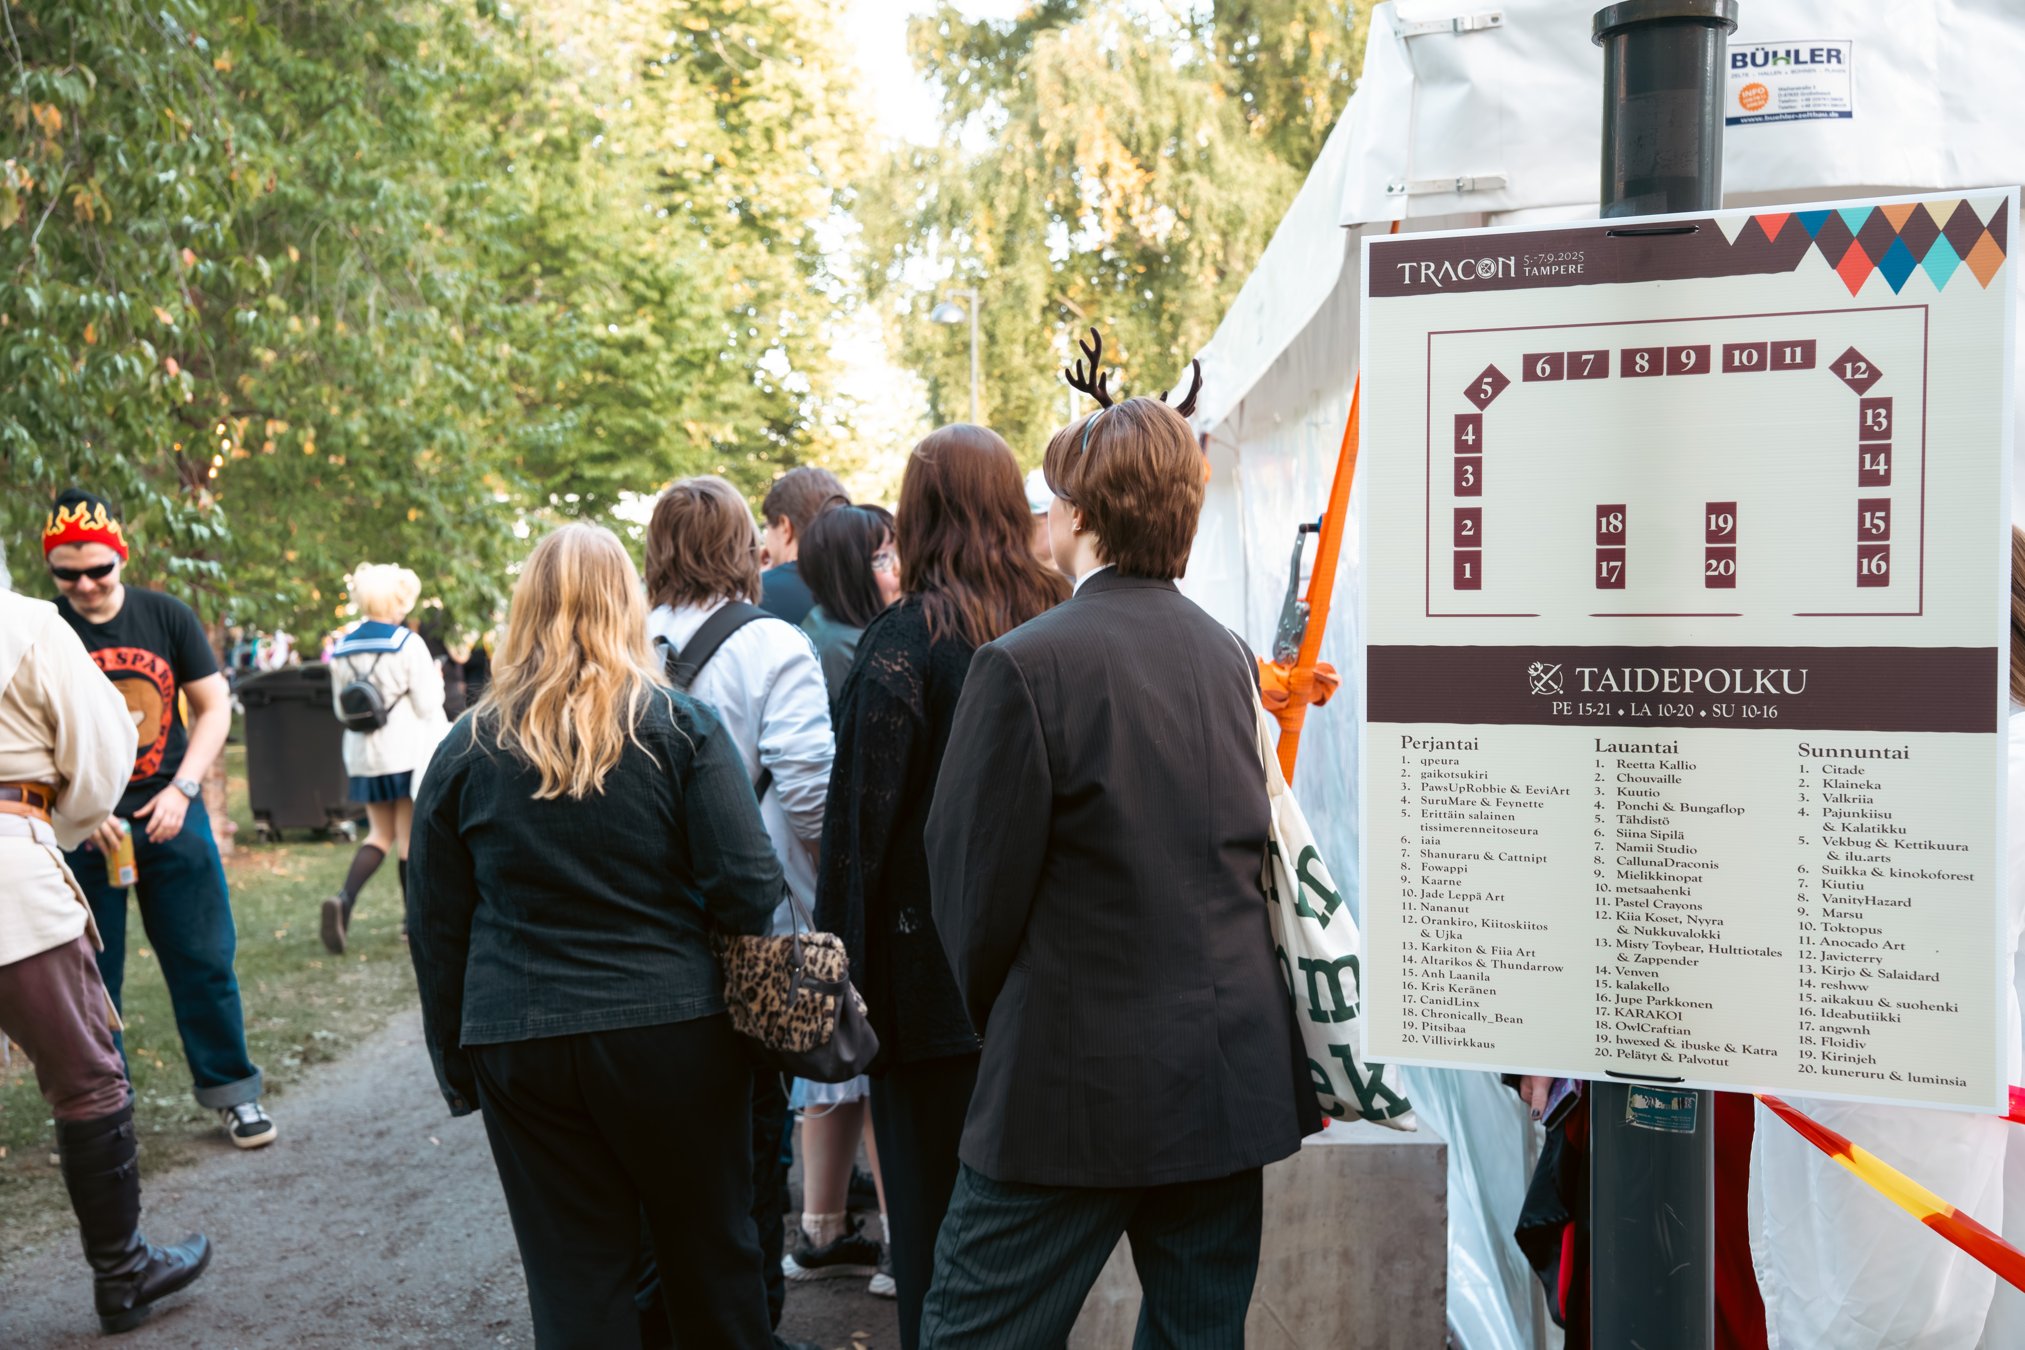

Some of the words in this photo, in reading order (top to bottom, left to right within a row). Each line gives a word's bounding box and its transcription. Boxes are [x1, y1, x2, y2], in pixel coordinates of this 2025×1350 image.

[1731, 48, 1842, 69] BÜHLER
[1524, 251, 1585, 266] 5.-7.9.2025
[1397, 256, 1516, 287] TRACON
[1523, 263, 1584, 277] TAMPERE
[1681, 349, 1697, 372] 9
[1732, 348, 1759, 367] 10
[1783, 346, 1803, 364] 11
[1535, 355, 1551, 378] 6
[1581, 353, 1595, 376] 7
[1634, 352, 1650, 374] 8
[1844, 360, 1870, 380] 12
[1480, 378, 1492, 398] 5
[1864, 407, 1888, 432] 13
[1460, 423, 1476, 445] 4
[1862, 452, 1889, 476] 14
[1461, 464, 1475, 487] 3
[1461, 519, 1475, 536] 2
[1599, 512, 1623, 534] 18
[1708, 513, 1734, 536] 19
[1862, 511, 1886, 535] 15
[1463, 562, 1473, 579] 1
[1705, 558, 1735, 577] 20
[1860, 552, 1888, 575] 16
[1599, 561, 1623, 583] 17
[1575, 667, 1808, 695] TAIDEPOLKU
[1552, 701, 1572, 715] PE
[1578, 702, 1611, 716] 15-21
[1630, 703, 1651, 717] LA
[1658, 703, 1694, 717] 10-20
[1712, 704, 1735, 718] SU
[1741, 705, 1778, 718] 10-16
[1400, 735, 1479, 753] Perjantai
[1594, 738, 1679, 754] Lauantai
[1797, 742, 1910, 760] Sunnuntai
[1616, 758, 1656, 770] Reetta
[1658, 759, 1697, 770] Kallio
[1821, 764, 1865, 775] Citade
[1420, 768, 1488, 780] gaikotsukiri
[1616, 772, 1682, 784] Chouvaille
[1420, 781, 1507, 794] PawsUpRobbie
[1509, 784, 1521, 794] &
[1616, 786, 1660, 797] Kuutio
[1822, 778, 1881, 790] Klaineka
[1420, 795, 1477, 806] SuruMare
[1480, 797, 1492, 807] &
[1495, 797, 1544, 809] Feynette
[1822, 792, 1874, 804] Valkriia
[1421, 808, 1465, 819] Erittäin
[1468, 810, 1515, 821] salainen
[1616, 800, 1659, 811] Ponchi
[1662, 801, 1676, 812] &
[1679, 802, 1745, 816] Bungaflop
[1822, 807, 1892, 820] Pajunkiisu
[1615, 814, 1670, 826] Tähdistö
[1616, 828, 1647, 839] Siina
[1649, 829, 1684, 841] Sipilä
[1822, 821, 1836, 832] &
[1840, 822, 1906, 835] Kalatikku
[1421, 835, 1441, 845] iaia
[1615, 841, 1653, 853] Namii
[1656, 843, 1698, 854] Studio
[1821, 835, 1872, 849] Vekbug
[1874, 838, 1889, 848] &
[1893, 838, 1969, 852] Kettikuura
[1419, 848, 1480, 860] Shanuraru
[1482, 851, 1495, 861] &
[1498, 851, 1547, 864] Cattnipt
[1616, 855, 1719, 869] CallunaDraconis
[1826, 850, 1840, 861] &
[1421, 861, 1468, 875] Fowappi
[1821, 864, 1867, 876] Suikka
[1870, 867, 1884, 877] &
[1889, 867, 1974, 882] kinokoforest
[1420, 875, 1462, 886] Kaarne
[1616, 869, 1703, 884] Mielikkinopat
[1615, 884, 1691, 896] metsaahenki
[1821, 878, 1864, 891] Kiutiu
[1419, 888, 1444, 900] Jade
[1448, 889, 1482, 902] Leppä
[1484, 891, 1504, 902] Art
[1420, 901, 1469, 914] Nananut
[1614, 896, 1649, 908] Pastel
[1652, 899, 1703, 912] Crayons
[1615, 910, 1641, 922] Kiia
[1686, 914, 1724, 927] Nyyra
[1822, 907, 1863, 920] Marsu
[1420, 928, 1431, 938] &
[1435, 928, 1463, 941] Ujka
[1616, 924, 1630, 935] &
[1633, 925, 1721, 940] Nukkuvalokki
[1819, 921, 1883, 936] Toktopus
[1421, 941, 1472, 954] Karkiton
[1475, 944, 1487, 955] &
[1491, 945, 1513, 956] Fiia
[1515, 947, 1535, 958] Art
[1615, 938, 1649, 951] Misty
[1819, 936, 1879, 949] Anocado
[1882, 940, 1905, 951] Art
[1420, 955, 1473, 967] Altarikos
[1475, 958, 1487, 968] &
[1490, 958, 1564, 972] Thundarrow
[1616, 952, 1630, 962] &
[1633, 953, 1699, 966] Zappender
[1421, 968, 1445, 979] Anh
[1448, 969, 1490, 982] Laanila
[1614, 965, 1659, 978] Venven
[1820, 964, 1856, 978] Kirjo
[1859, 967, 1873, 978] &
[1877, 968, 1940, 982] Salaidard
[1421, 981, 1445, 992] Kris
[1448, 983, 1497, 996] Keränen
[1615, 979, 1670, 993] kalakello
[1419, 994, 1480, 1008] CanidLinx
[1614, 993, 1643, 1006] Jupe
[1646, 995, 1713, 1010] Parkkonen
[1820, 994, 1874, 1007] aikakuu
[1877, 997, 1892, 1008] &
[1896, 999, 1958, 1013] suohenki
[1614, 1006, 1682, 1021] KARAKOI
[1820, 1007, 1901, 1023] Ideabutiikki
[1421, 1020, 1466, 1034] Pitsibaa
[1421, 1034, 1495, 1049] Villivirkkaus
[1821, 1036, 1866, 1049] Floidiv
[1616, 1048, 1657, 1062] Pelätyt
[1660, 1052, 1674, 1062] &
[1678, 1052, 1729, 1067] Palvotut
[1888, 1070, 1903, 1082] &
[1907, 1071, 1967, 1087] luminsia
